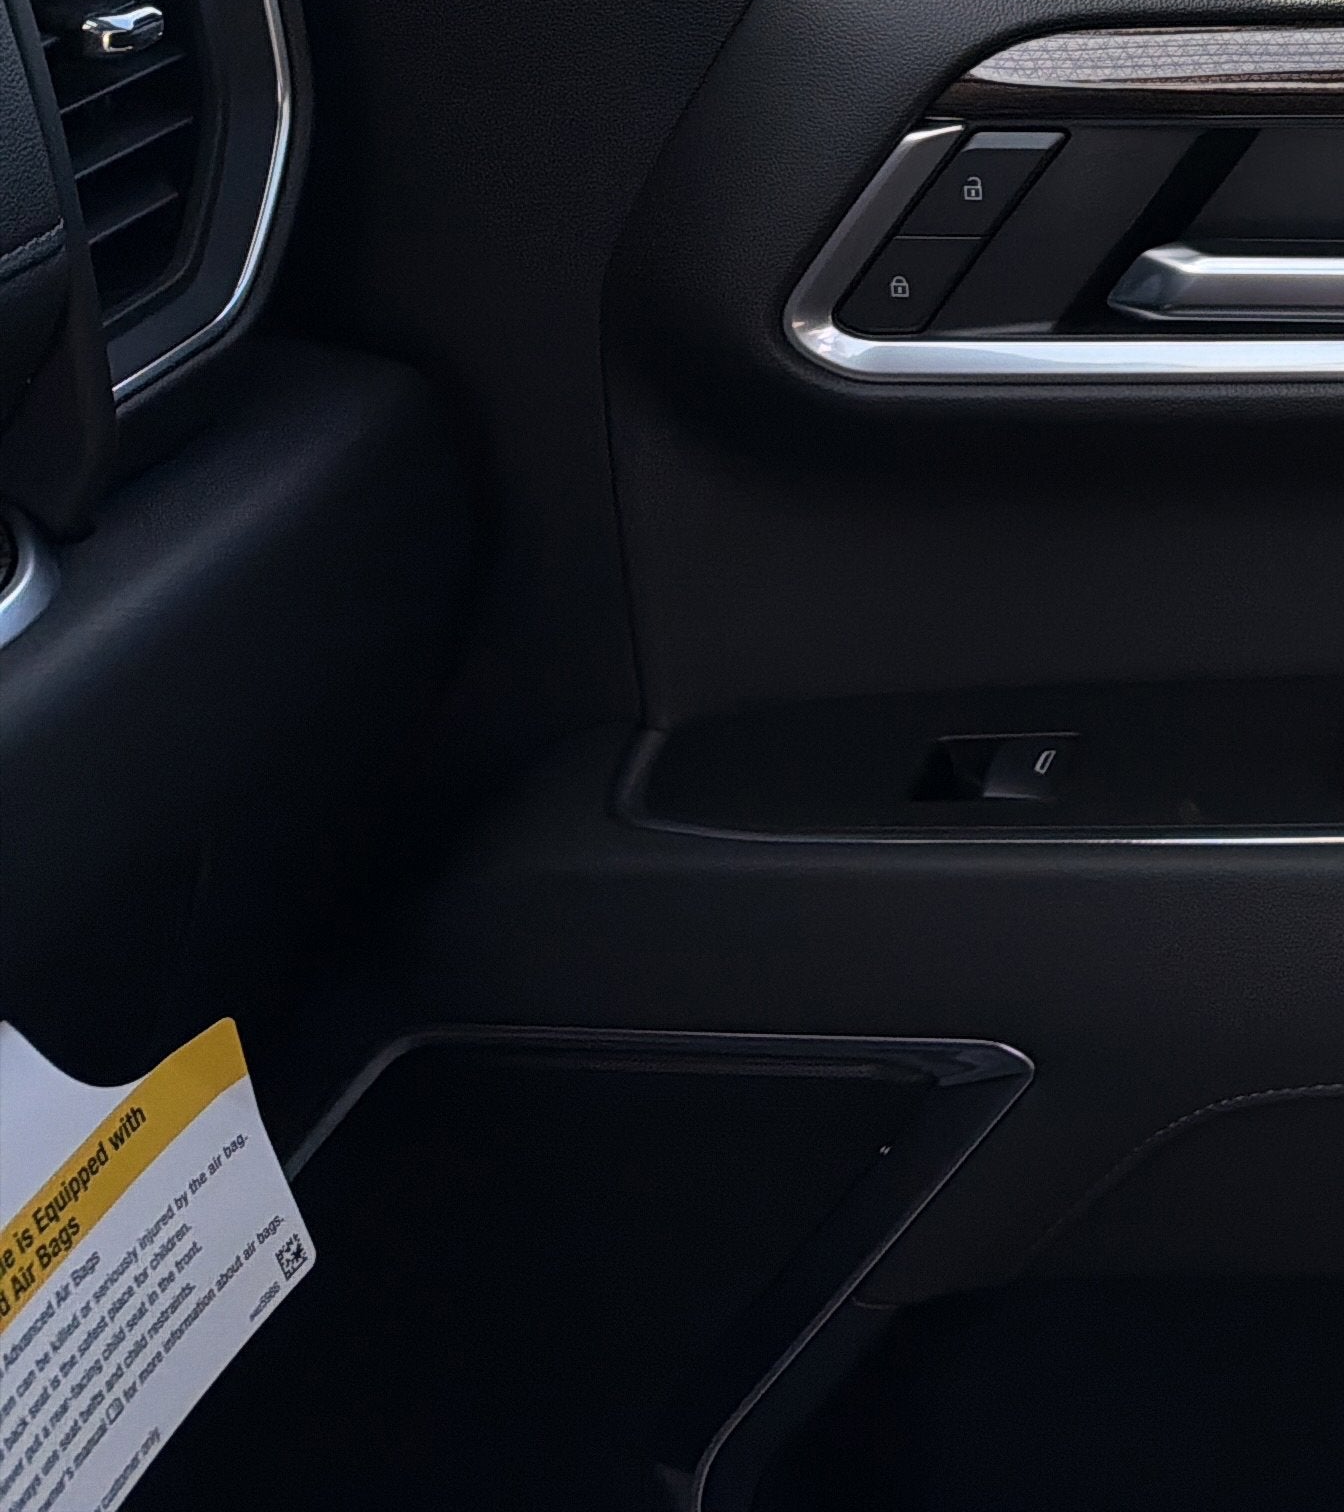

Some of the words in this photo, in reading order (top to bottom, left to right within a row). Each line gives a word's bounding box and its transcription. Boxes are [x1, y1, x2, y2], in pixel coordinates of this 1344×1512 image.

[13, 1228, 34, 1254] is
[32, 1140, 109, 1234] Equipped
[108, 1106, 147, 1151] with
[3, 1300, 55, 1371] Advanced
[55, 1282, 71, 1309] Air
[71, 1251, 101, 1287] Bags
[11, 1262, 36, 1301] Air
[36, 1216, 80, 1271] Bags
[16, 1369, 36, 1398] can
[35, 1351, 51, 1372] be
[93, 1247, 139, 1304] seriously
[137, 1204, 175, 1250] injured
[174, 1191, 188, 1211] by
[189, 1172, 207, 1195] the
[208, 1154, 222, 1176] air
[223, 1134, 248, 1159] bag.
[60, 1354, 79, 1378] the
[107, 1285, 136, 1323] place
[134, 1266, 150, 1288] for
[150, 1223, 192, 1270] children.
[102, 1326, 126, 1361] child
[126, 1301, 149, 1332] seat
[147, 1290, 160, 1307] in
[159, 1270, 176, 1294] the
[175, 1241, 203, 1274] front.
[123, 1380, 139, 1403] for
[139, 1350, 163, 1385] more
[163, 1287, 217, 1355] information
[216, 1255, 244, 1292] about
[242, 1240, 257, 1261] air
[256, 1216, 285, 1245] bags.
[123, 1334, 149, 1369] child
[147, 1283, 197, 1339] restraints.
